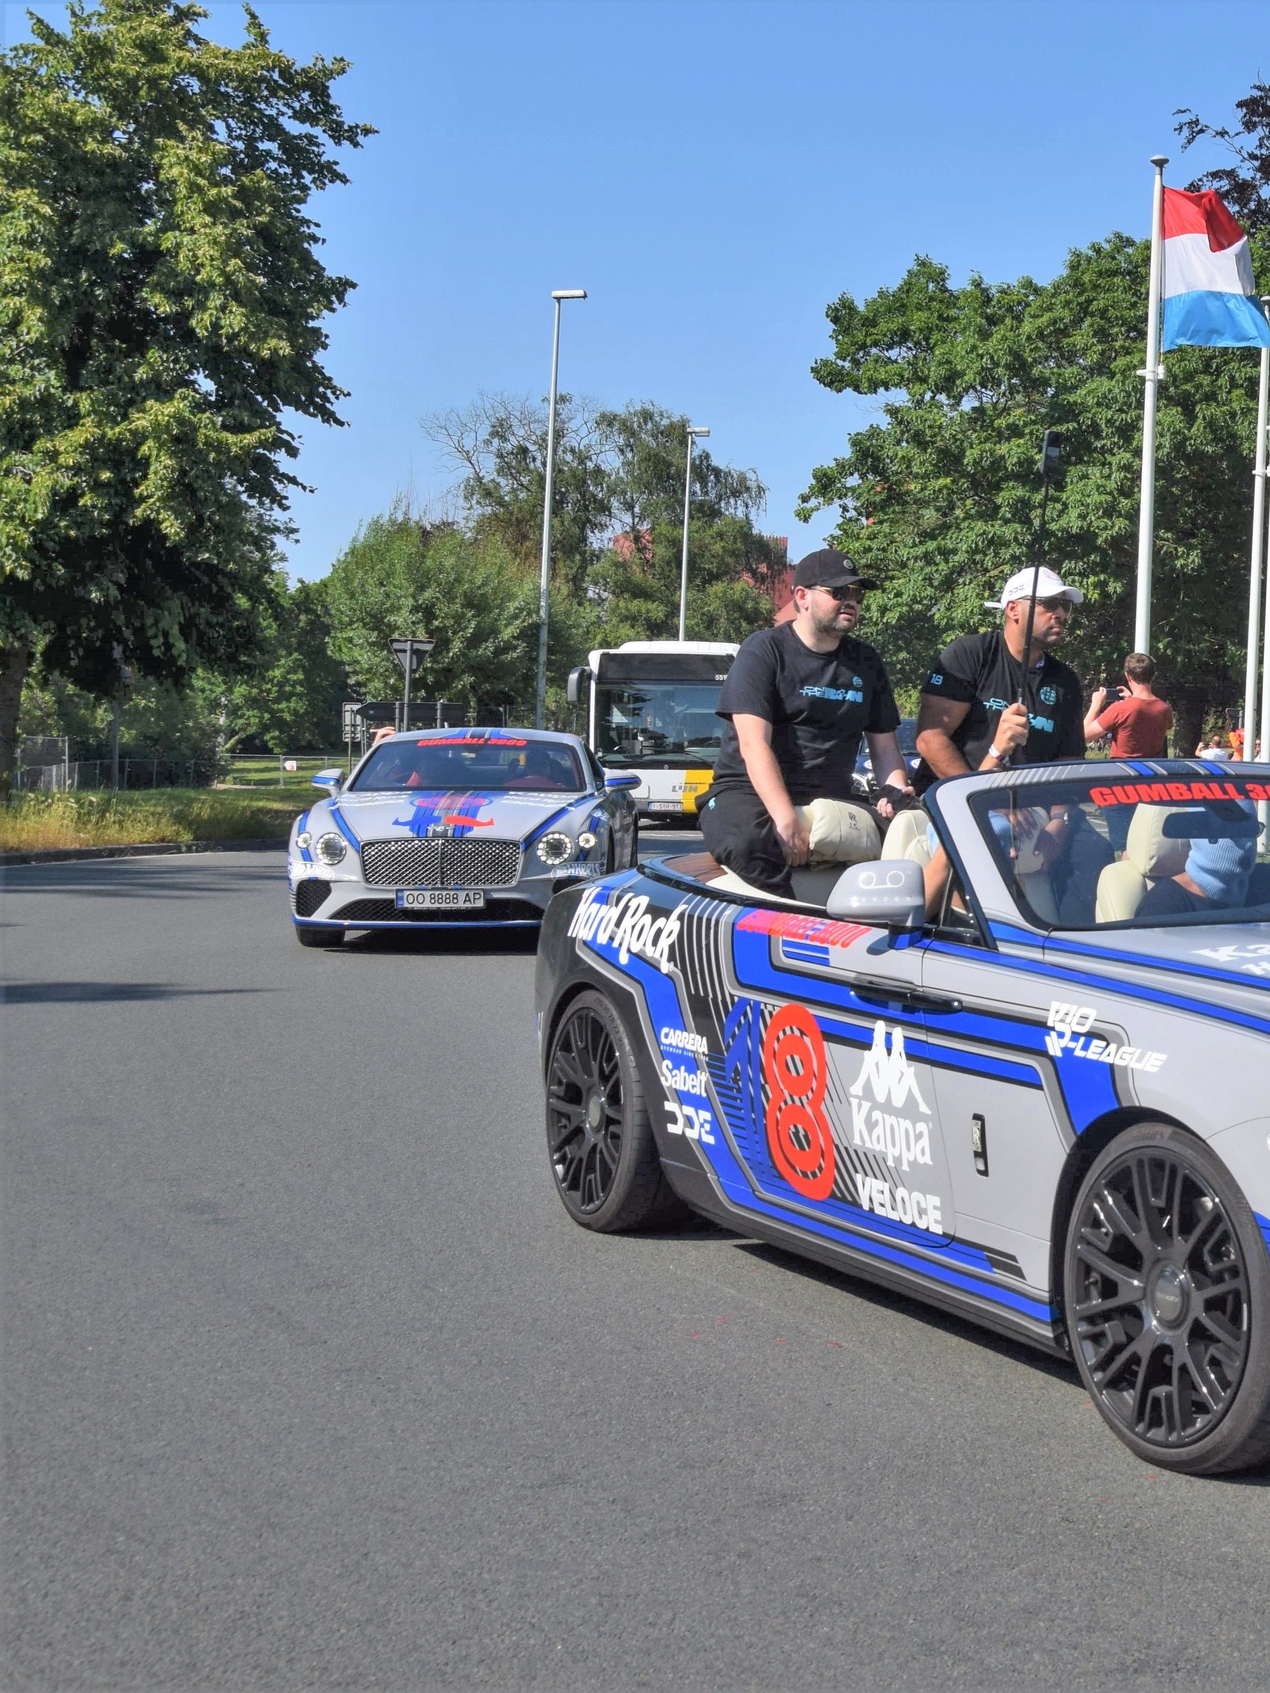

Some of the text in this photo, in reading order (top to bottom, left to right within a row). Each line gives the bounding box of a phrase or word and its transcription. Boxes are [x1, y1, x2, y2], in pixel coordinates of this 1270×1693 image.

[930, 673, 944, 685] 18
[417, 737, 527, 747] GUMBALL 3000
[1089, 782, 1245, 807] GUMBALL
[429, 893, 459, 904] 8888
[462, 892, 482, 904] AP
[567, 887, 689, 974] Hard Rock
[1047, 1001, 1097, 1033] V10
[661, 1027, 709, 1055] CARRERA
[661, 1060, 707, 1097] Sabelt
[850, 1097, 933, 1171] Kappa
[856, 1173, 943, 1234] VELOCE
